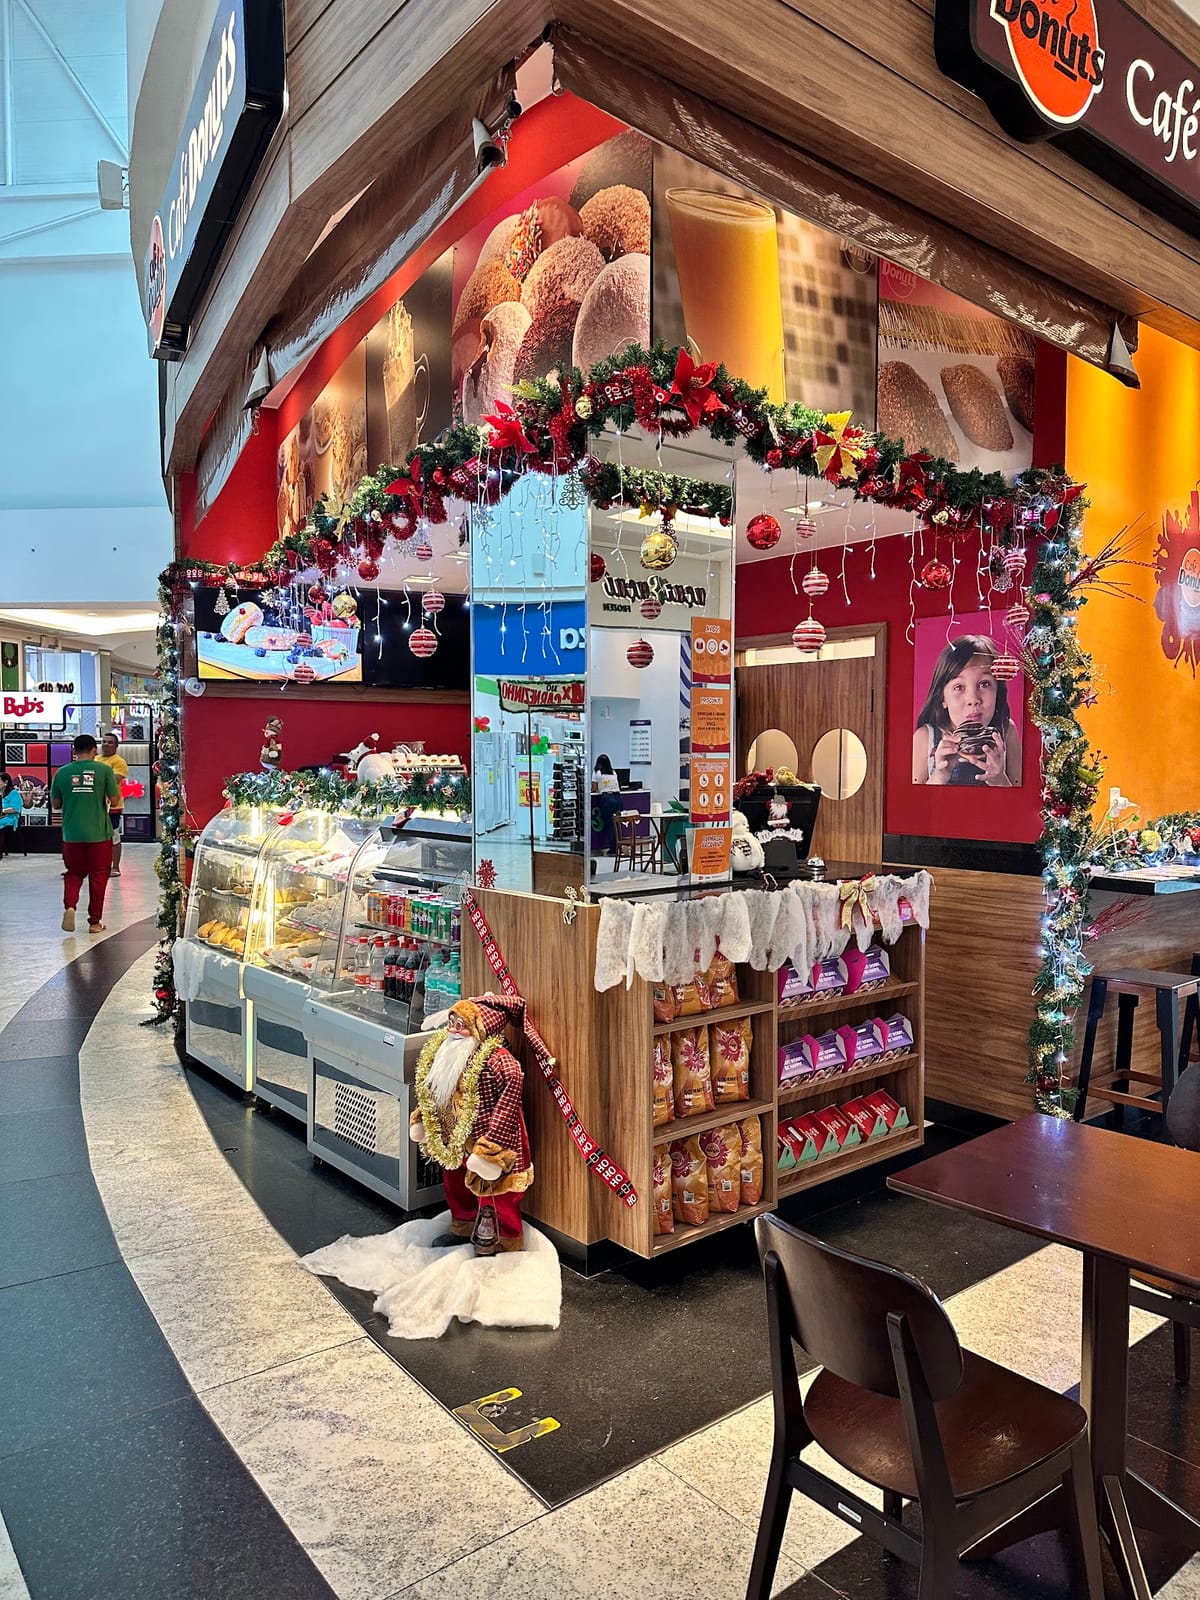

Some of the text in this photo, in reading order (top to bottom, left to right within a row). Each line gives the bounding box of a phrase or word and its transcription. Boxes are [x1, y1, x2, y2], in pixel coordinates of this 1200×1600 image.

[1126, 58, 1200, 163] Café
[168, 10, 236, 260] Café Donuts
[1179, 568, 1200, 590] Donu
[3, 696, 44, 717] Bob's
[471, 911, 481, 922] HO
[475, 919, 484, 930] HO
[486, 944, 495, 955] HO
[490, 952, 499, 963] HO
[494, 960, 502, 971] HO
[554, 1086, 563, 1099] HO
[558, 1095, 567, 1107] HO
[562, 1103, 571, 1115] HO
[573, 1124, 583, 1137] HO
[577, 1134, 587, 1146] HO
[595, 1159, 609, 1173] HO
[602, 1166, 616, 1180] HO
[609, 1173, 624, 1188] HO
[626, 1194, 637, 1206] HO
